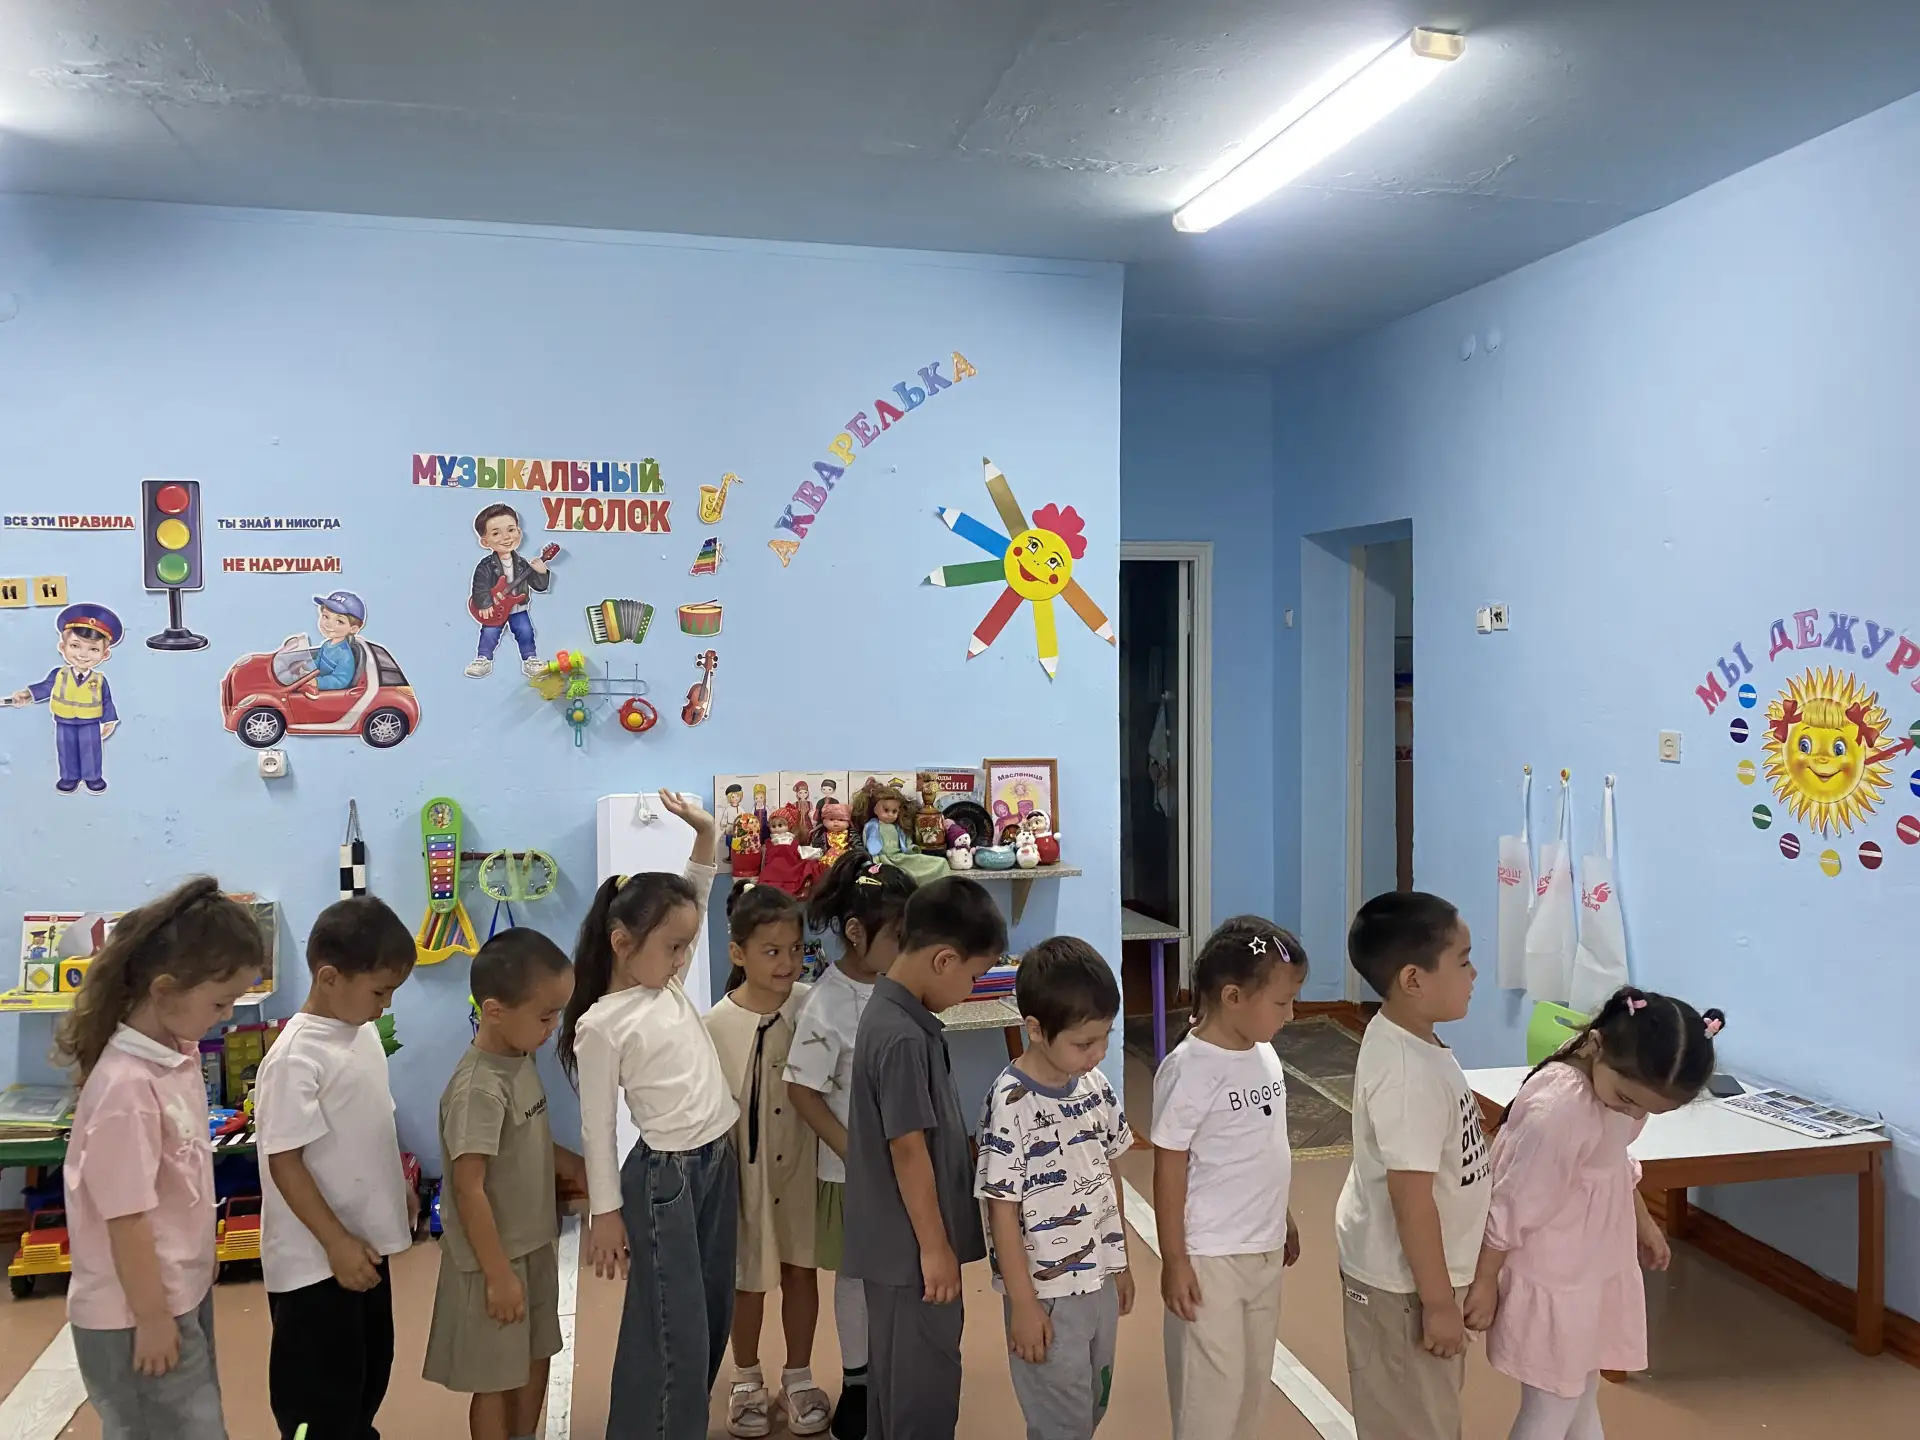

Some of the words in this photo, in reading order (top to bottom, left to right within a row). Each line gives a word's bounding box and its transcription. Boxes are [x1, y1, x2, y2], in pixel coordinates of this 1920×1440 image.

[767, 351, 977, 568] АКВАРЕЛЬКА
[412, 454, 663, 493] МУЗЫКАЛЬНЫЙ
[3, 515, 28, 526] ВСЕ
[31, 516, 56, 526] ЭТИ
[58, 515, 135, 528] ПРАВИЛА
[217, 519, 236, 529] ТЫ
[239, 516, 271, 529] ЗНАЙ
[274, 518, 283, 528] И
[286, 518, 341, 530] НИКОГДА
[541, 497, 672, 533] УГОЛОК
[222, 558, 245, 571] НЕ
[248, 555, 341, 572] НАРУШАЙ!
[1695, 641, 1754, 715] МЫ
[1768, 608, 1920, 694] ДЕЖУР
[997, 771, 1043, 781] Масленица
[939, 781, 968, 790] ССИИ
